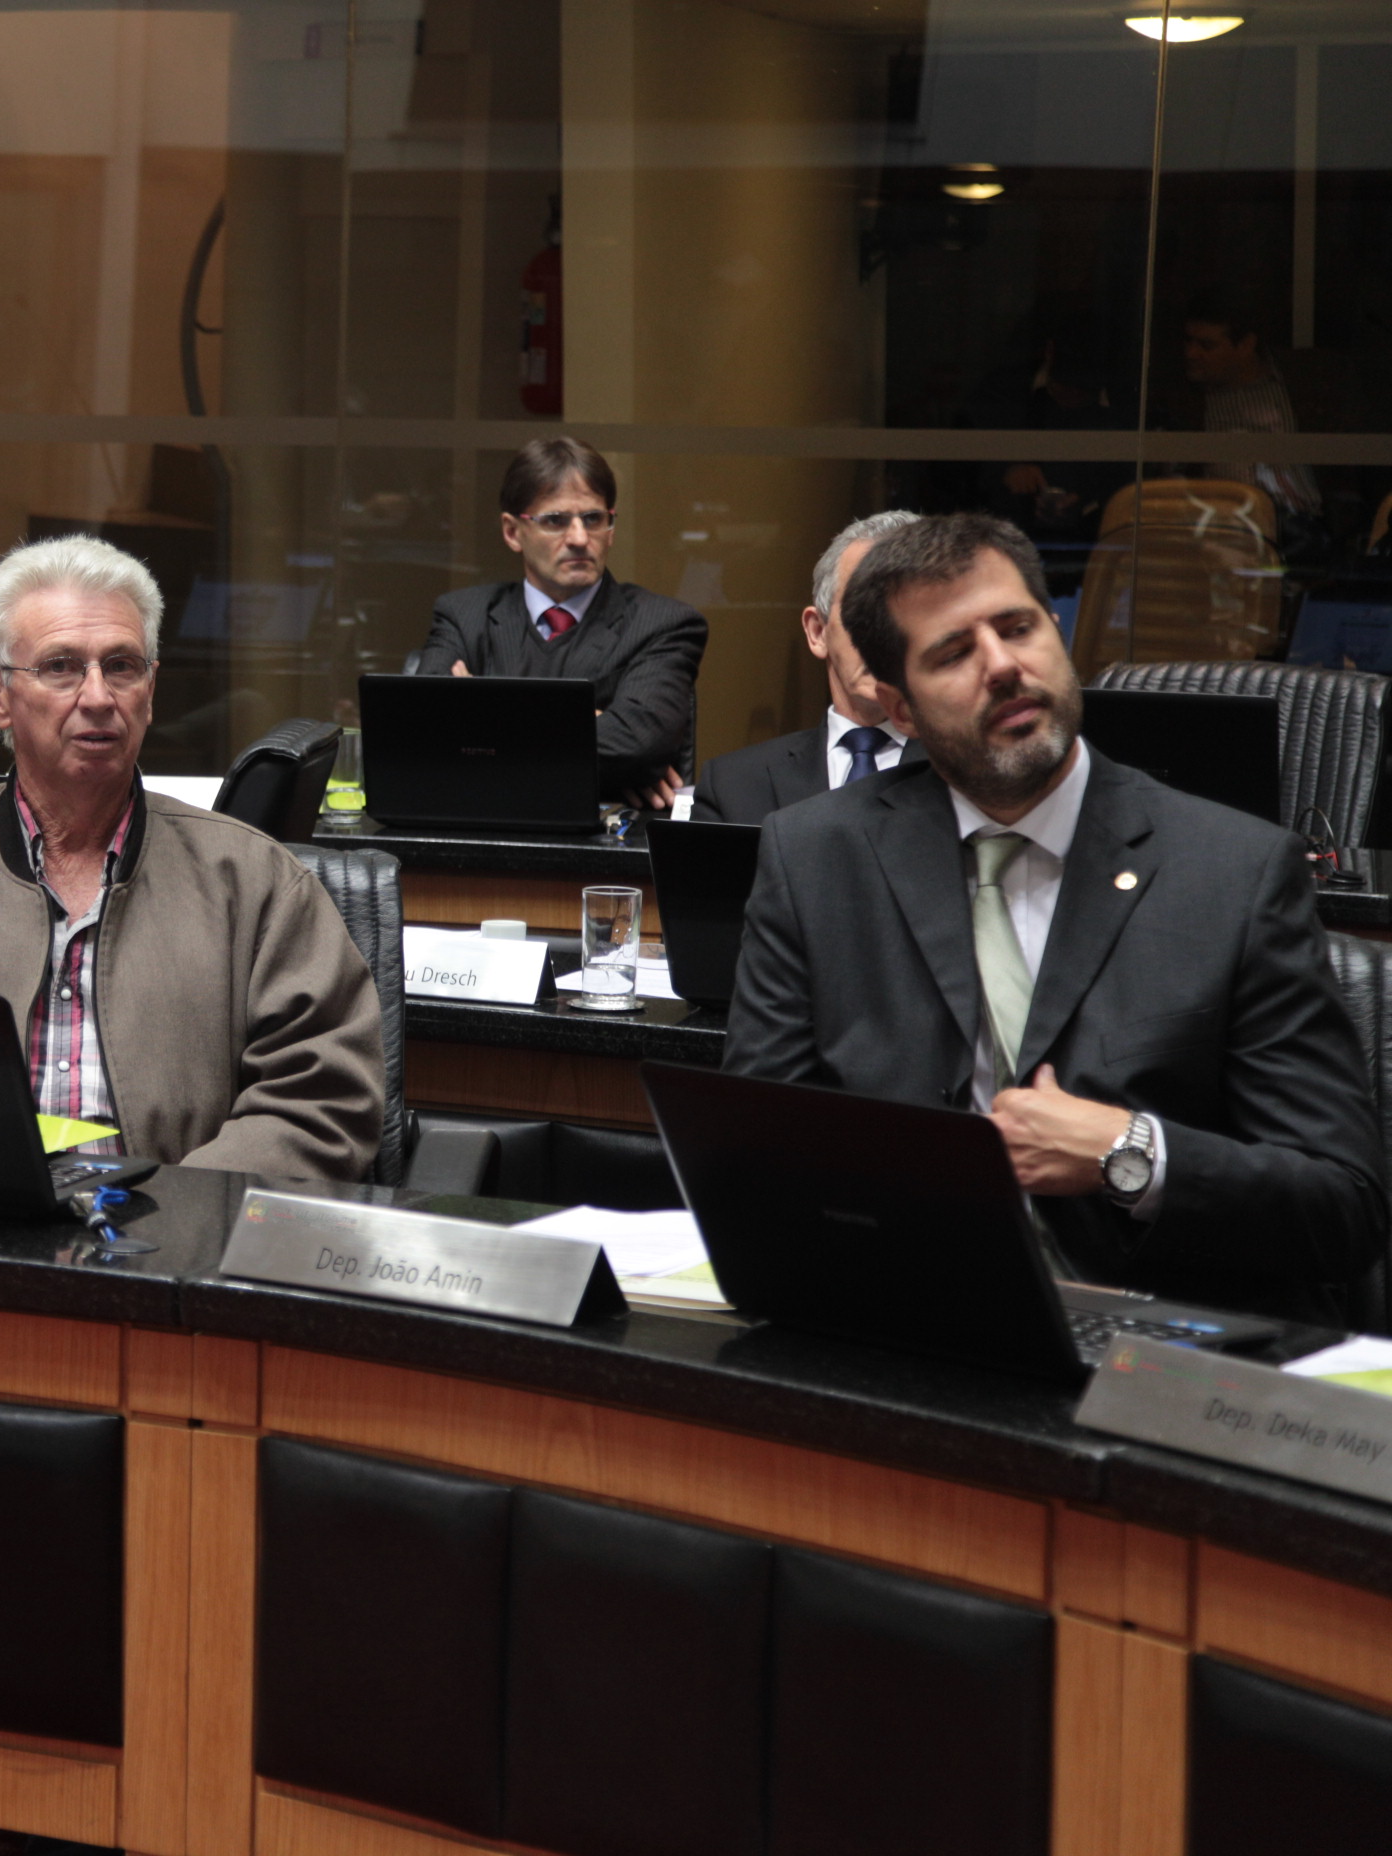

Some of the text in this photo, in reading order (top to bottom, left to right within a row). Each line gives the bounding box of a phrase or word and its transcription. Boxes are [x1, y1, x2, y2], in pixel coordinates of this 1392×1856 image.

[421, 966, 477, 987] Dresch
[315, 1247, 483, 1295] Dep. João Amin
[1204, 1397, 1387, 1465] Dep. Deka May
